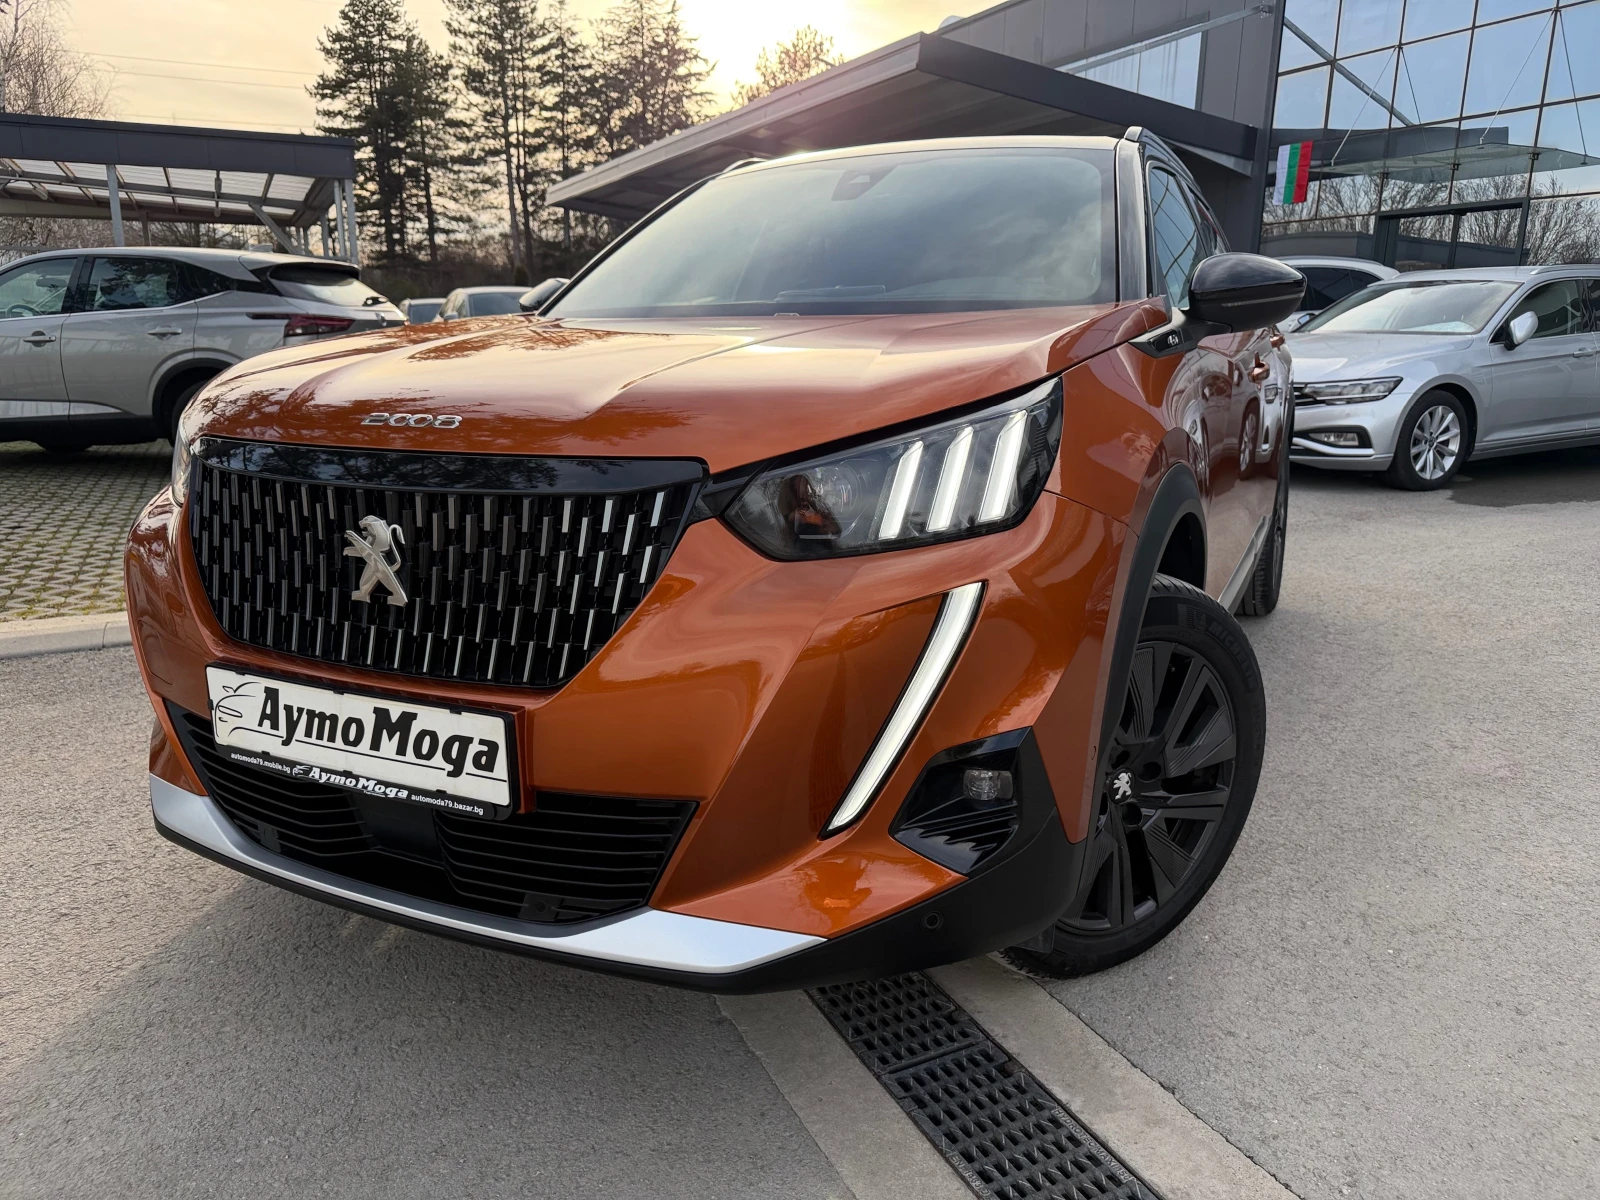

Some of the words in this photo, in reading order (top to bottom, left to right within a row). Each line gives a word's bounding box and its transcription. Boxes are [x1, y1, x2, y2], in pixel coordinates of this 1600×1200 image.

[361, 412, 462, 428] 2008
[231, 753, 291, 773] automoda79.mobile.bg
[411, 794, 484, 815] automoda79.bazar.bg
